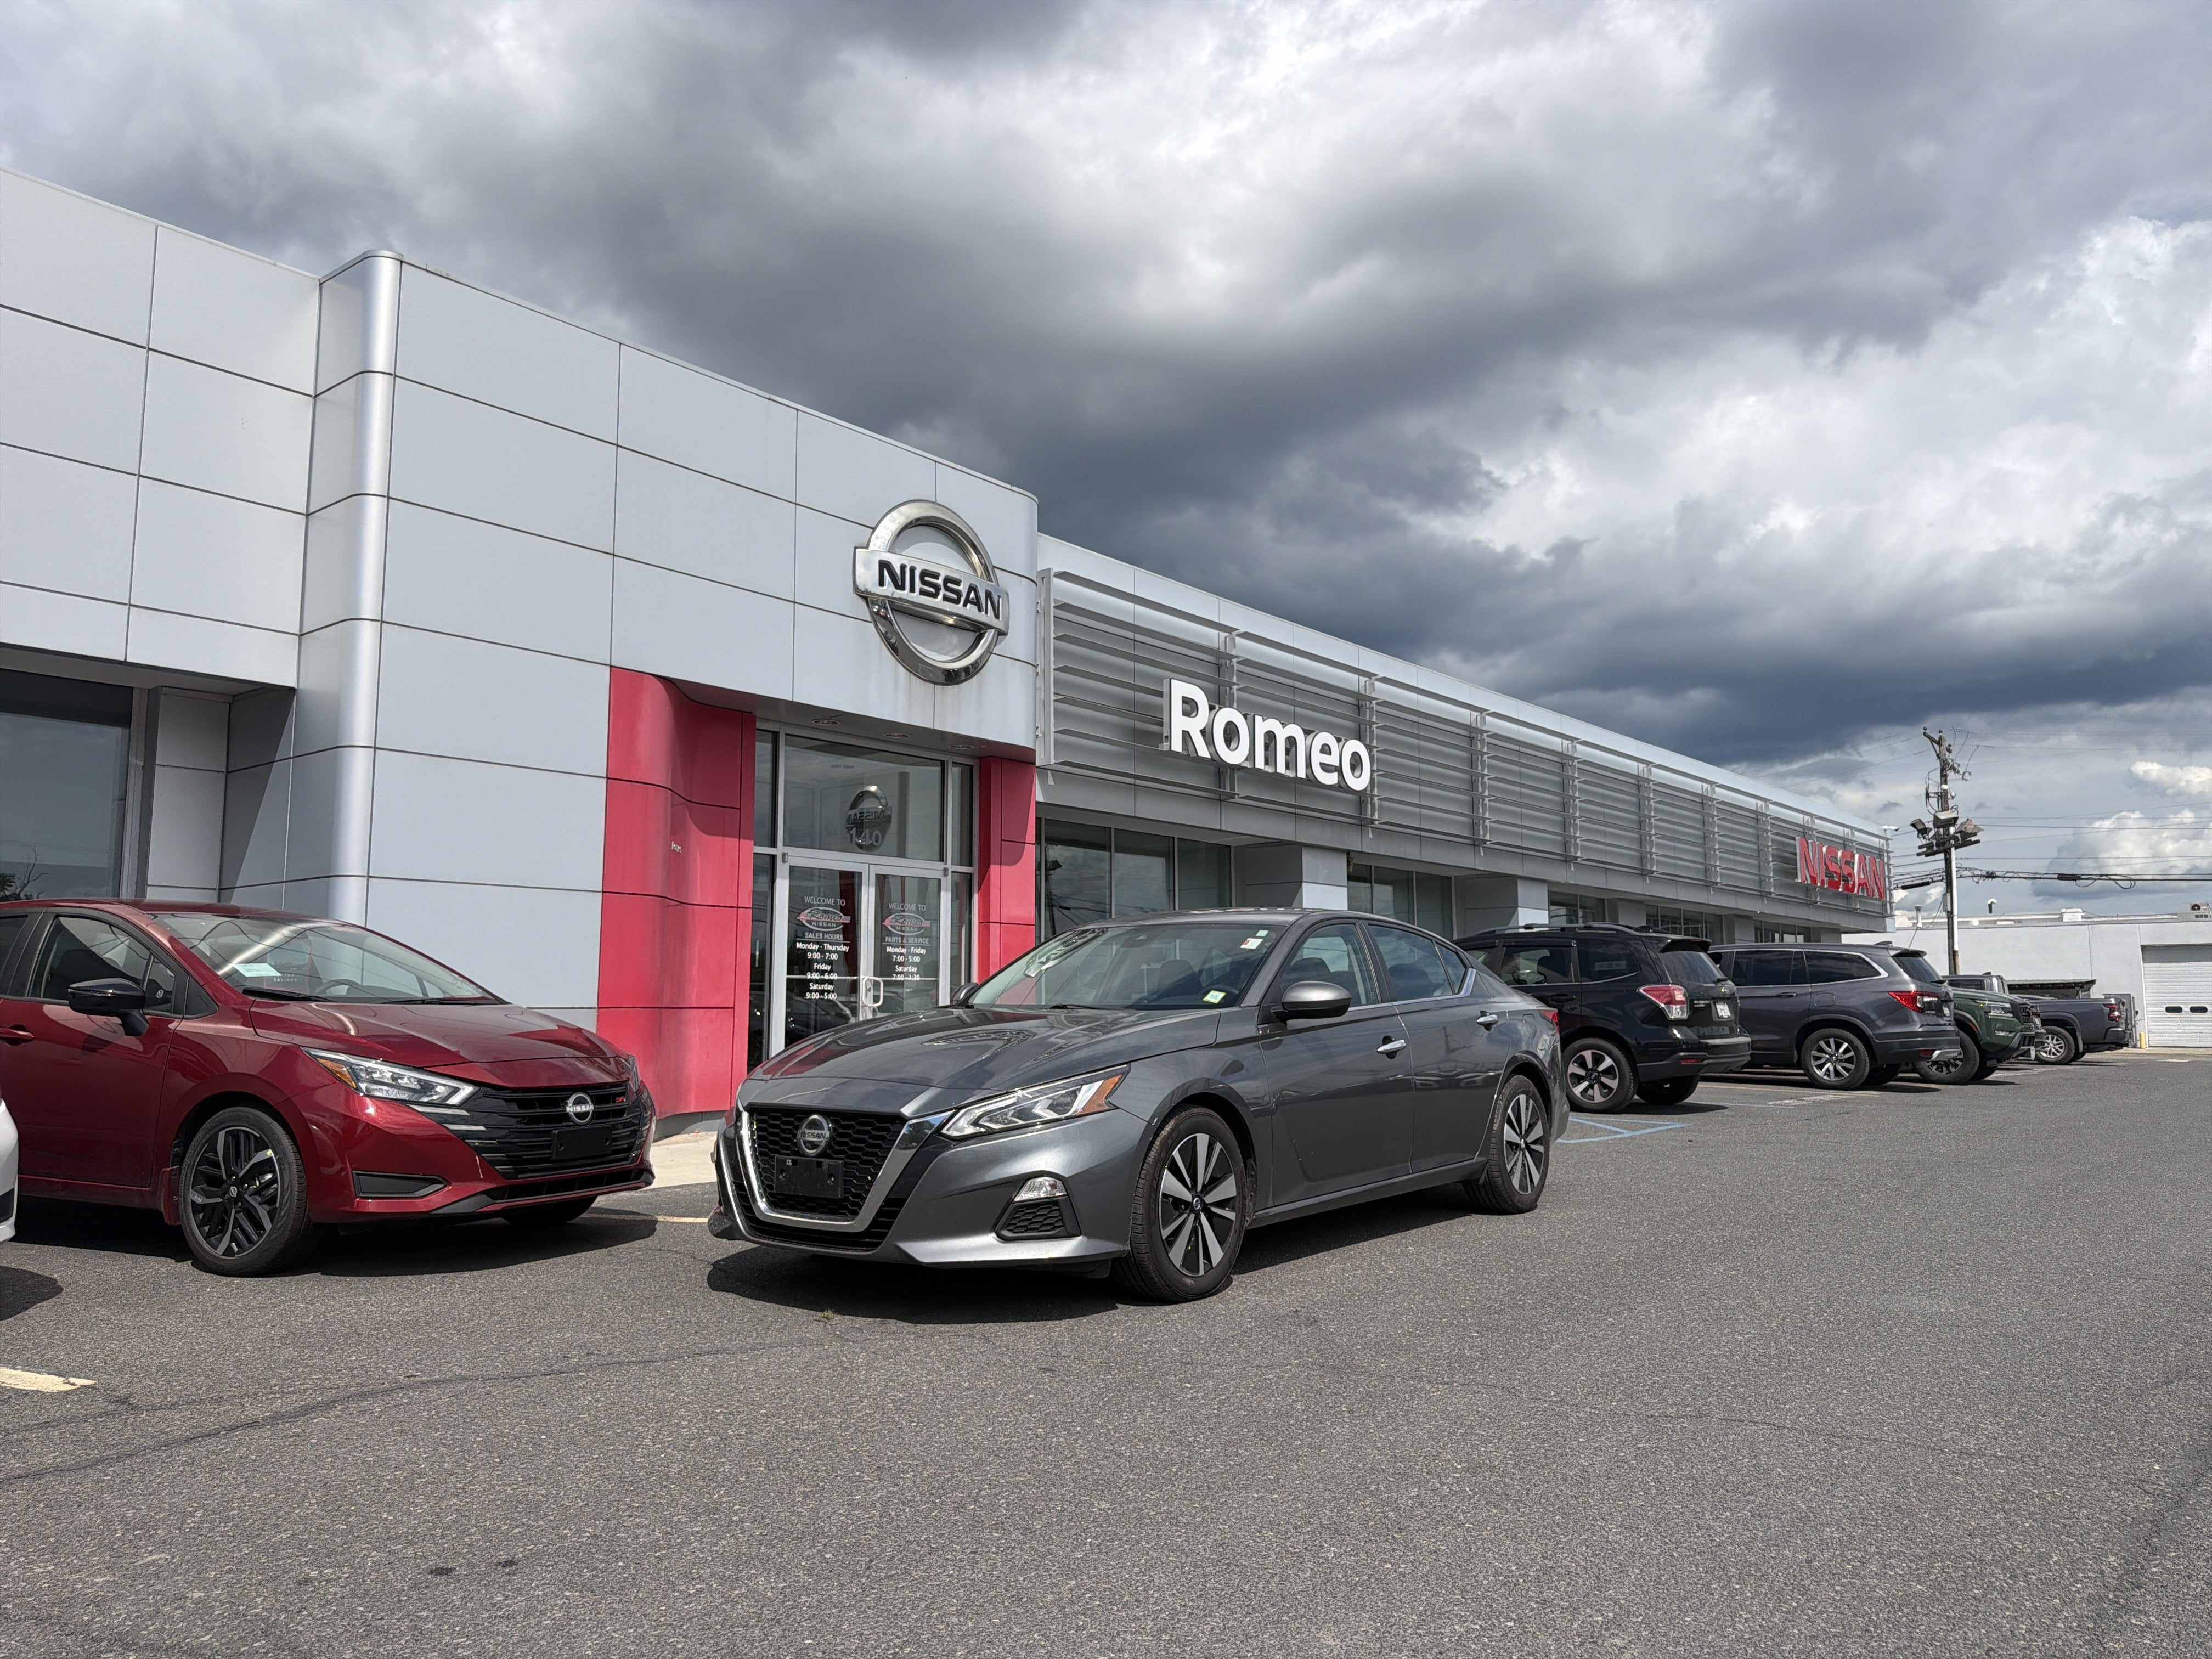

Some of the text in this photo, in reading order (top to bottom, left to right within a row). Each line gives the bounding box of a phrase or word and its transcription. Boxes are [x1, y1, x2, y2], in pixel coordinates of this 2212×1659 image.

[878, 559, 1001, 620] NISSAN
[1164, 678, 1370, 791] Romeo
[849, 828, 882, 846] 140
[1796, 837, 1886, 900] NISSAN
[804, 896, 835, 905] WELCOME
[809, 909, 842, 921] Romeo
[892, 915, 923, 925] Romeo
[797, 942, 819, 951] Monday
[823, 944, 849, 952] Thursday
[566, 1104, 594, 1113] NISSAN
[800, 1130, 826, 1139] NISSAN
